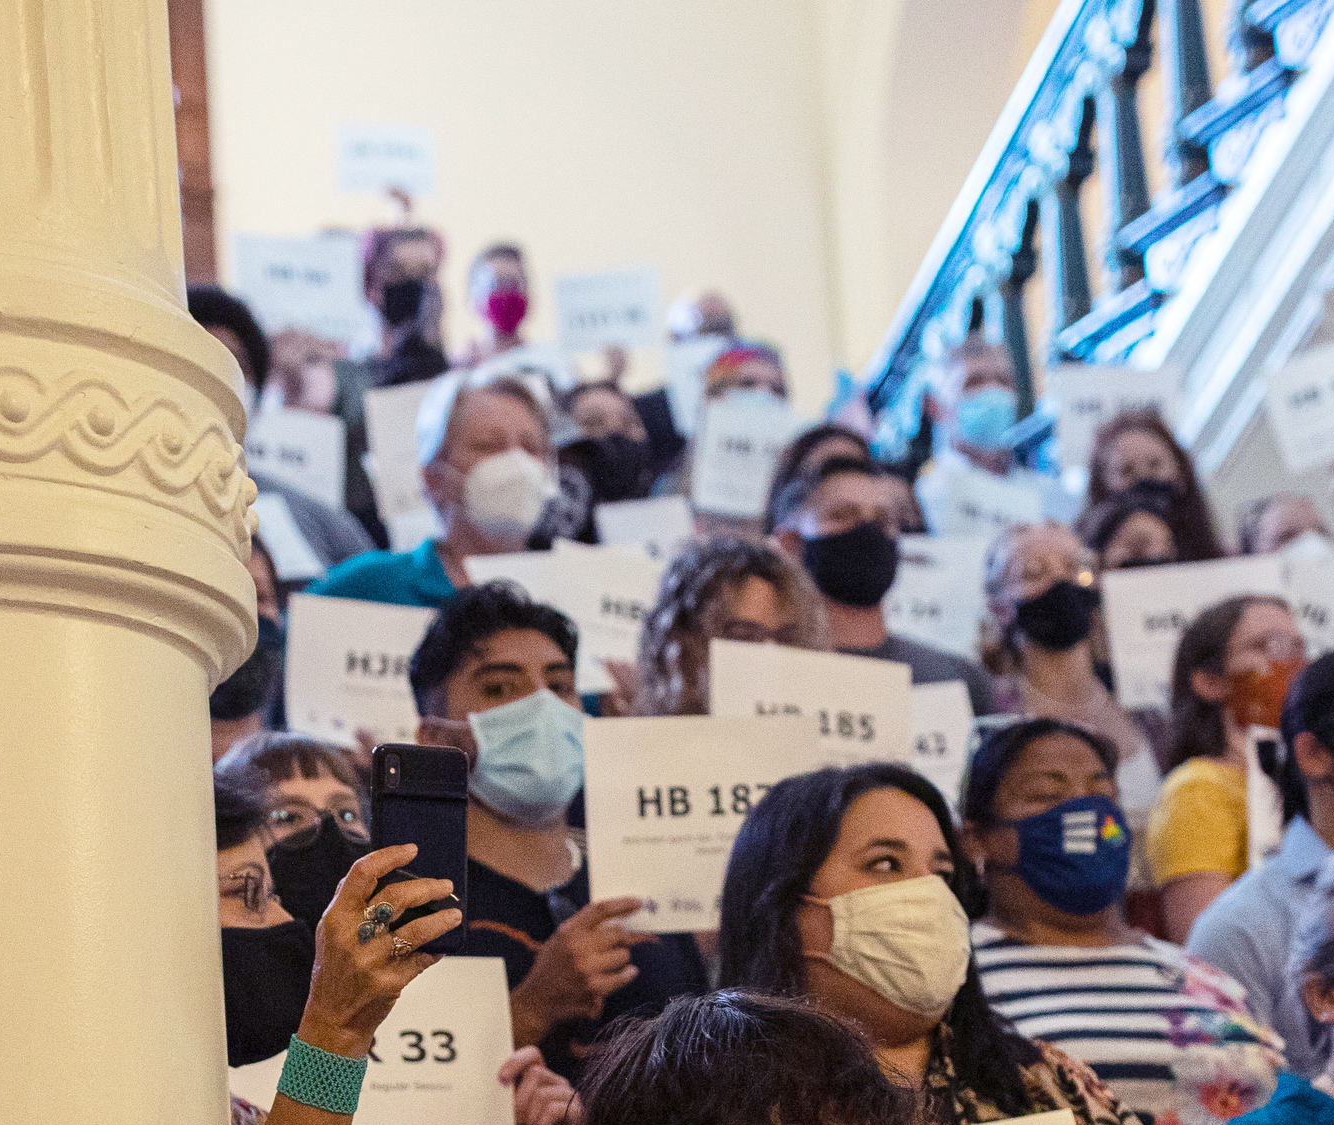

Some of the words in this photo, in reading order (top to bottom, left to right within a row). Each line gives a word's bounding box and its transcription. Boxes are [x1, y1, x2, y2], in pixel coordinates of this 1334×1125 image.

[819, 710, 875, 742] 185
[637, 786, 691, 818] HB
[399, 1030, 456, 1062] 33
